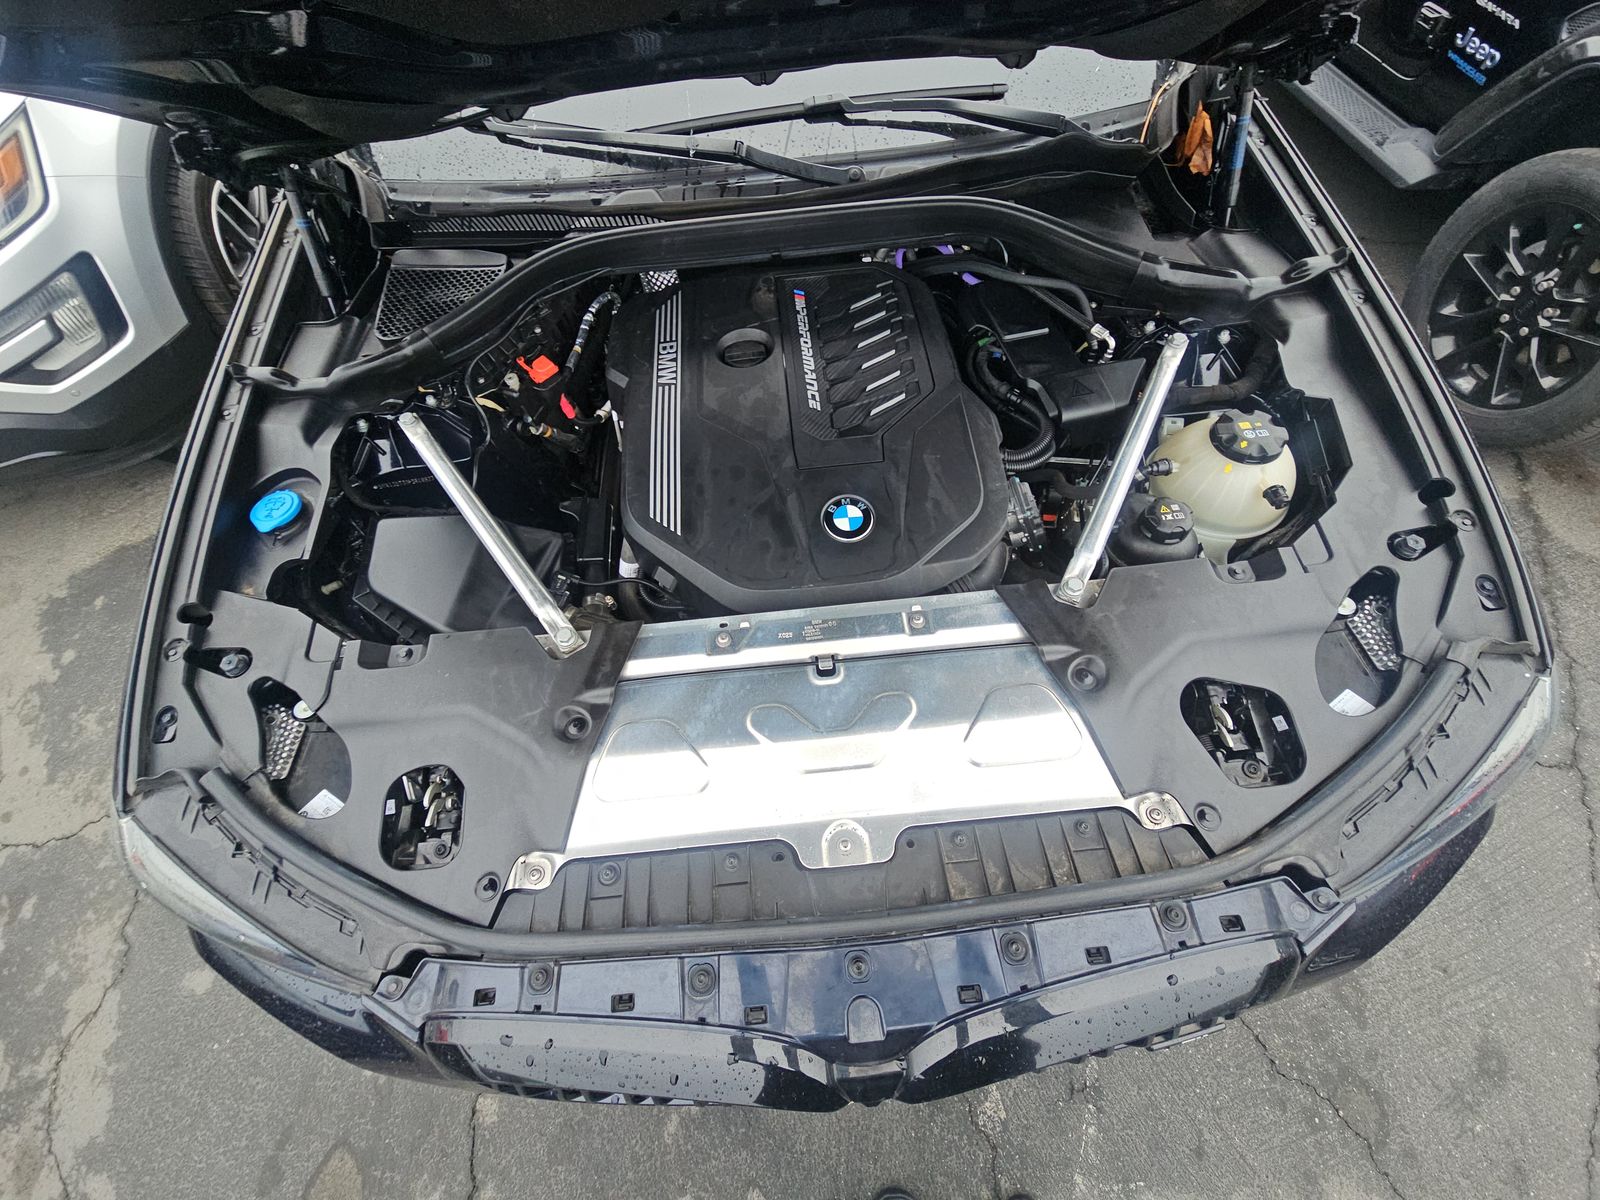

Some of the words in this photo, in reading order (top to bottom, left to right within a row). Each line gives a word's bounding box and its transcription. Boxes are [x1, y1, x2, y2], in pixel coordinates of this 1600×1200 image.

[1455, 26, 1501, 70] Jeep
[657, 341, 677, 384] BMW
[827, 498, 867, 513] BMW
